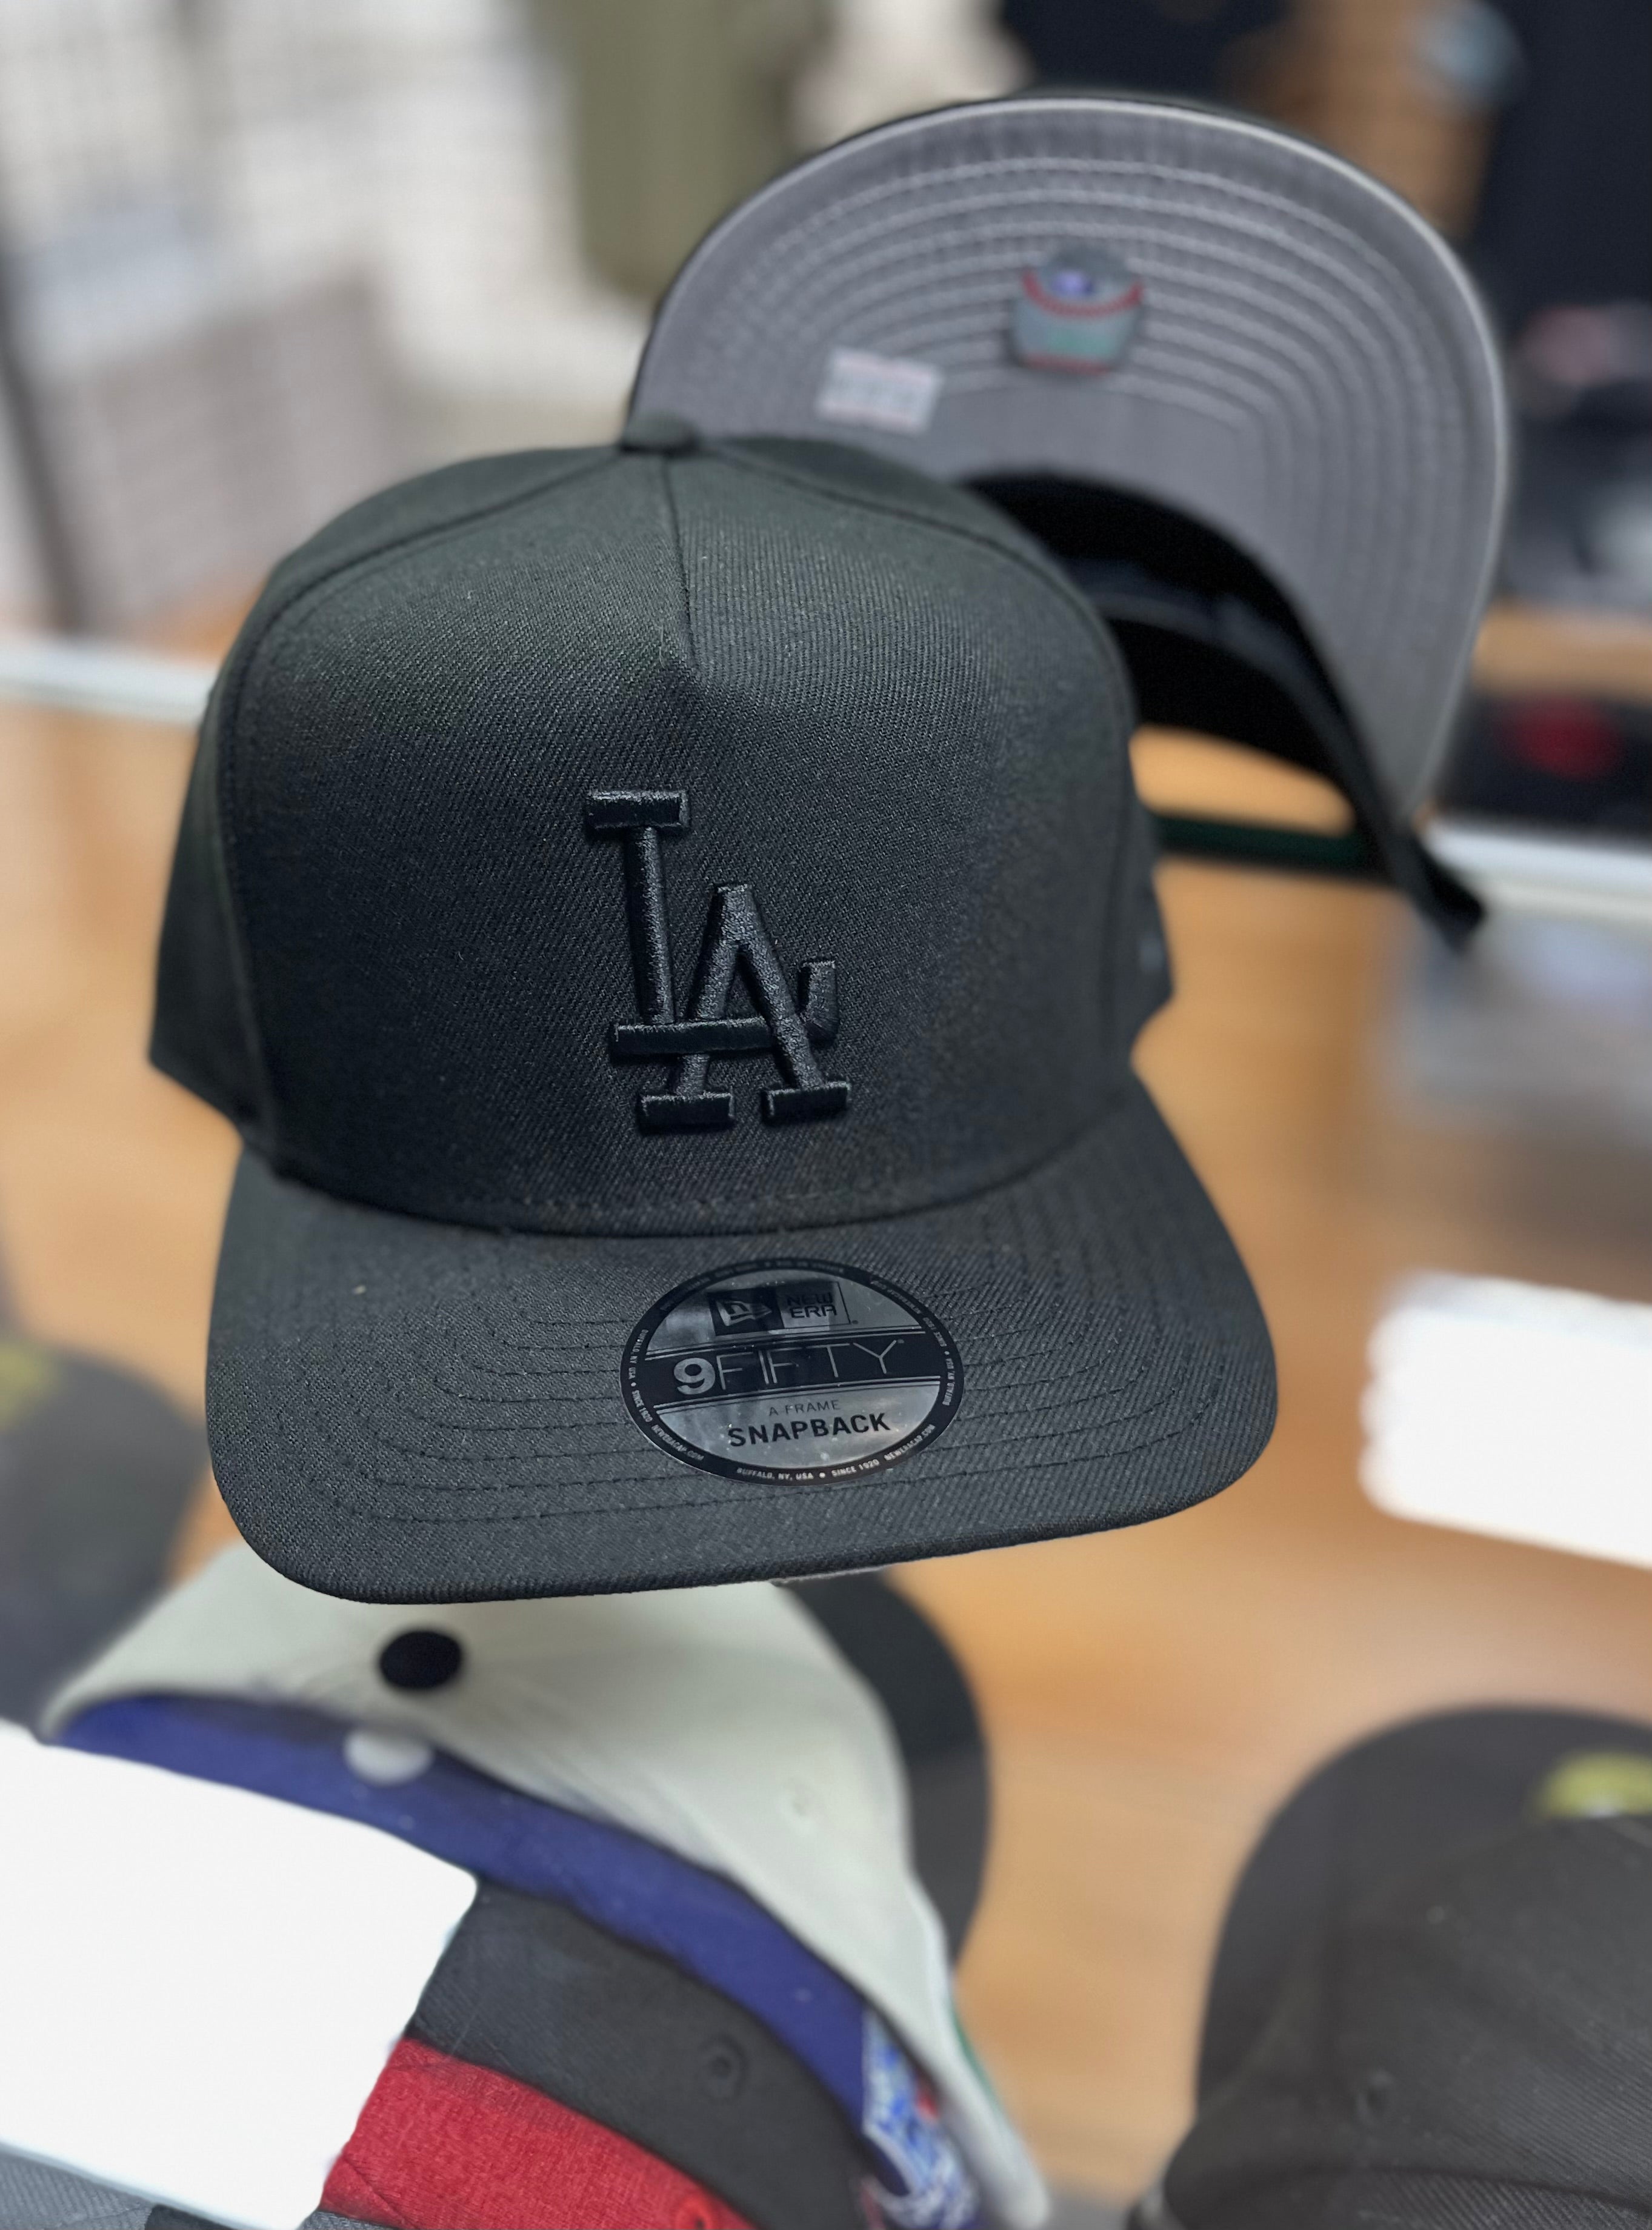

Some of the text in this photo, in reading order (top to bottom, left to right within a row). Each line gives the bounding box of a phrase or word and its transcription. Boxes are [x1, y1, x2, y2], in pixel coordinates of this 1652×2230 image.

[586, 790, 850, 1135] LA
[788, 1292, 834, 1306] NEW
[790, 1304, 838, 1319] ERA
[673, 1340, 897, 1395] 9FIFTY
[785, 1399, 841, 1414] FRAME
[727, 1412, 891, 1447] SNAPBACK
[796, 1471, 814, 1480] USA
[831, 1465, 858, 1477] SINCE
[858, 1458, 880, 1471] 1920
